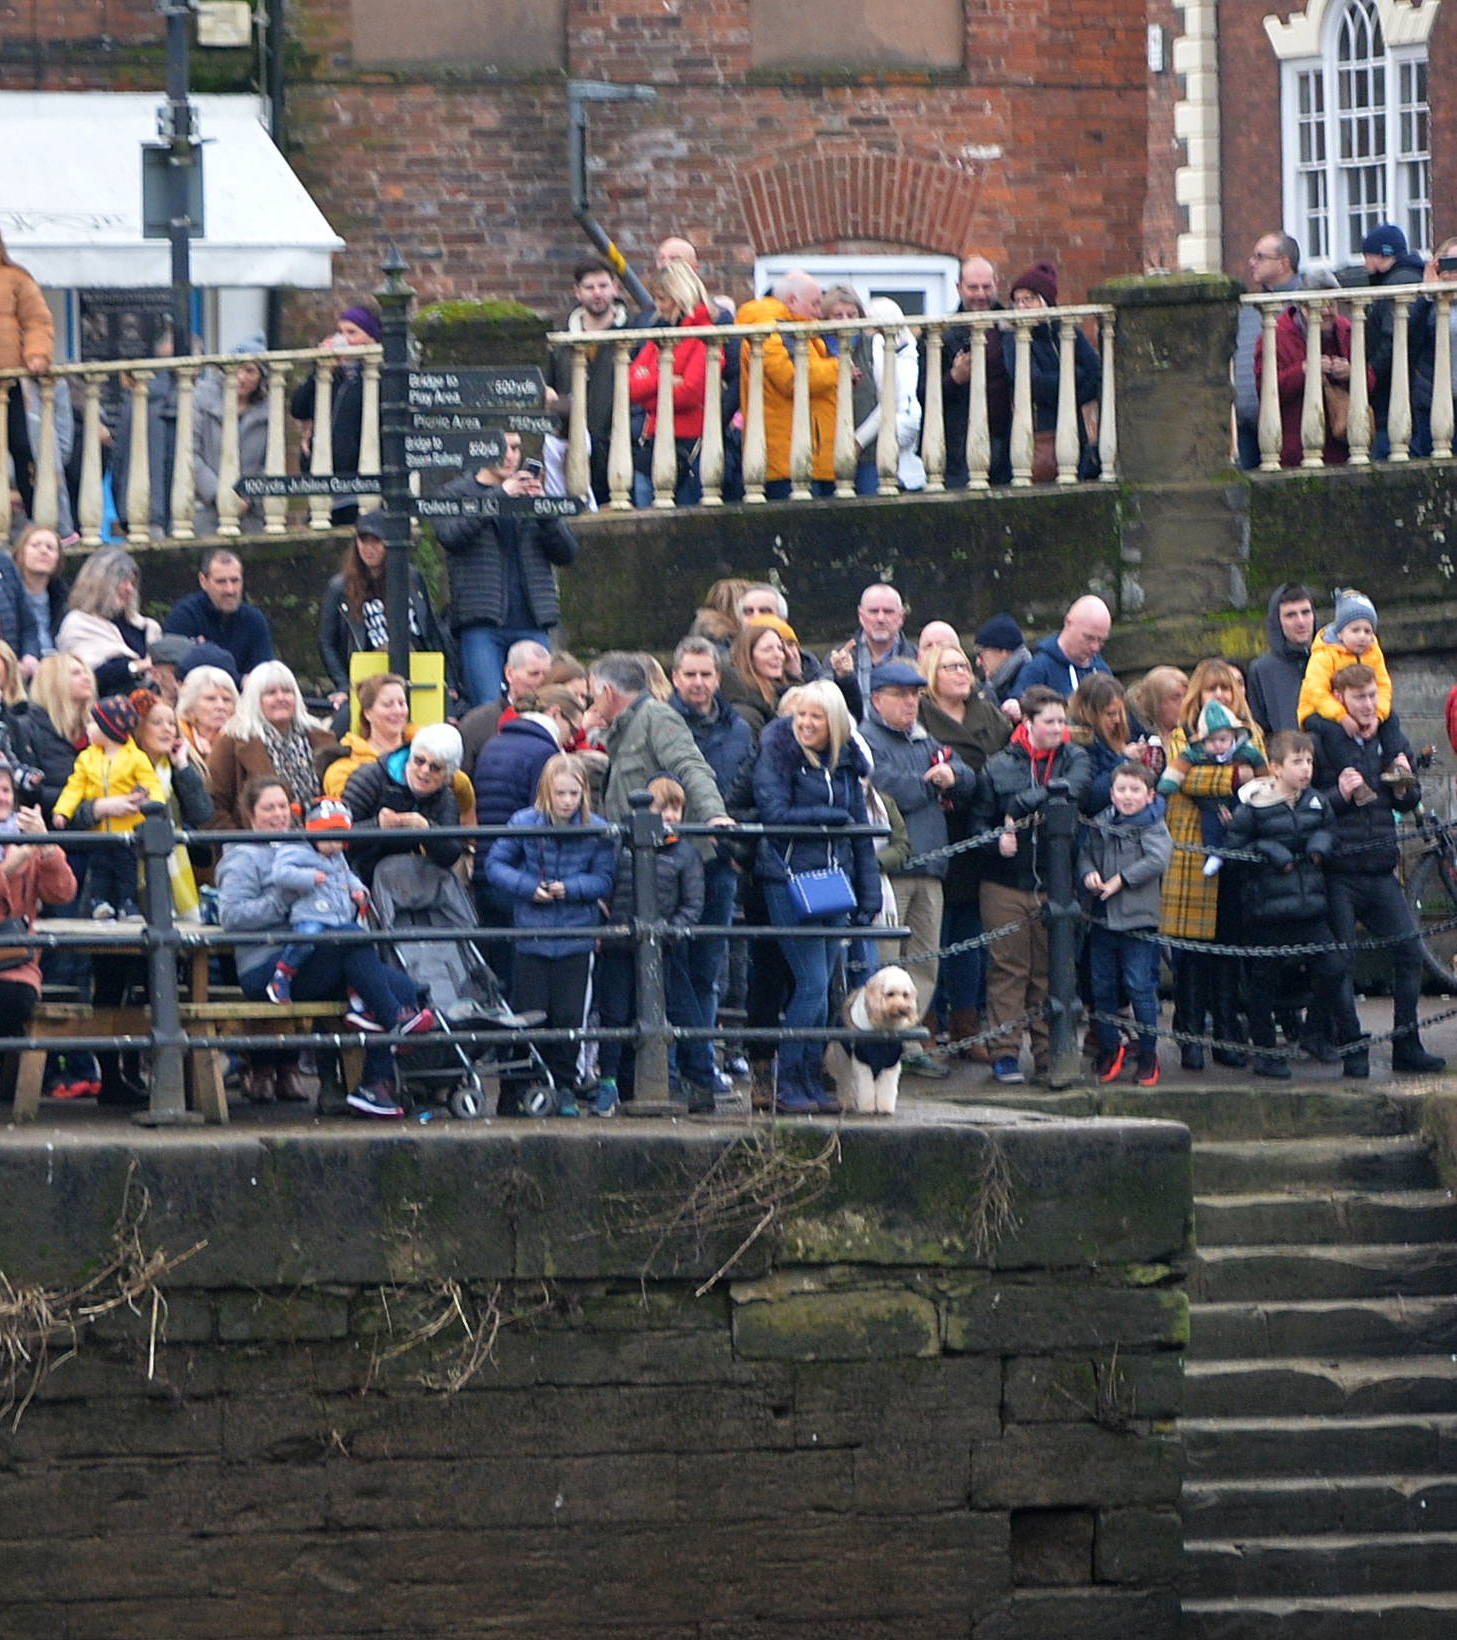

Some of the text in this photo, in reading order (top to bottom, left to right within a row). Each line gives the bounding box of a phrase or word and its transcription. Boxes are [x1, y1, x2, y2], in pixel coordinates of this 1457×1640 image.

[408, 372, 460, 391] Bridge to
[408, 389, 462, 407] Play Area
[413, 413, 450, 429] Picnic
[451, 414, 482, 430] Area
[243, 477, 380, 497] 100yds Jubilee Gardens
[416, 498, 459, 516] Toilets
